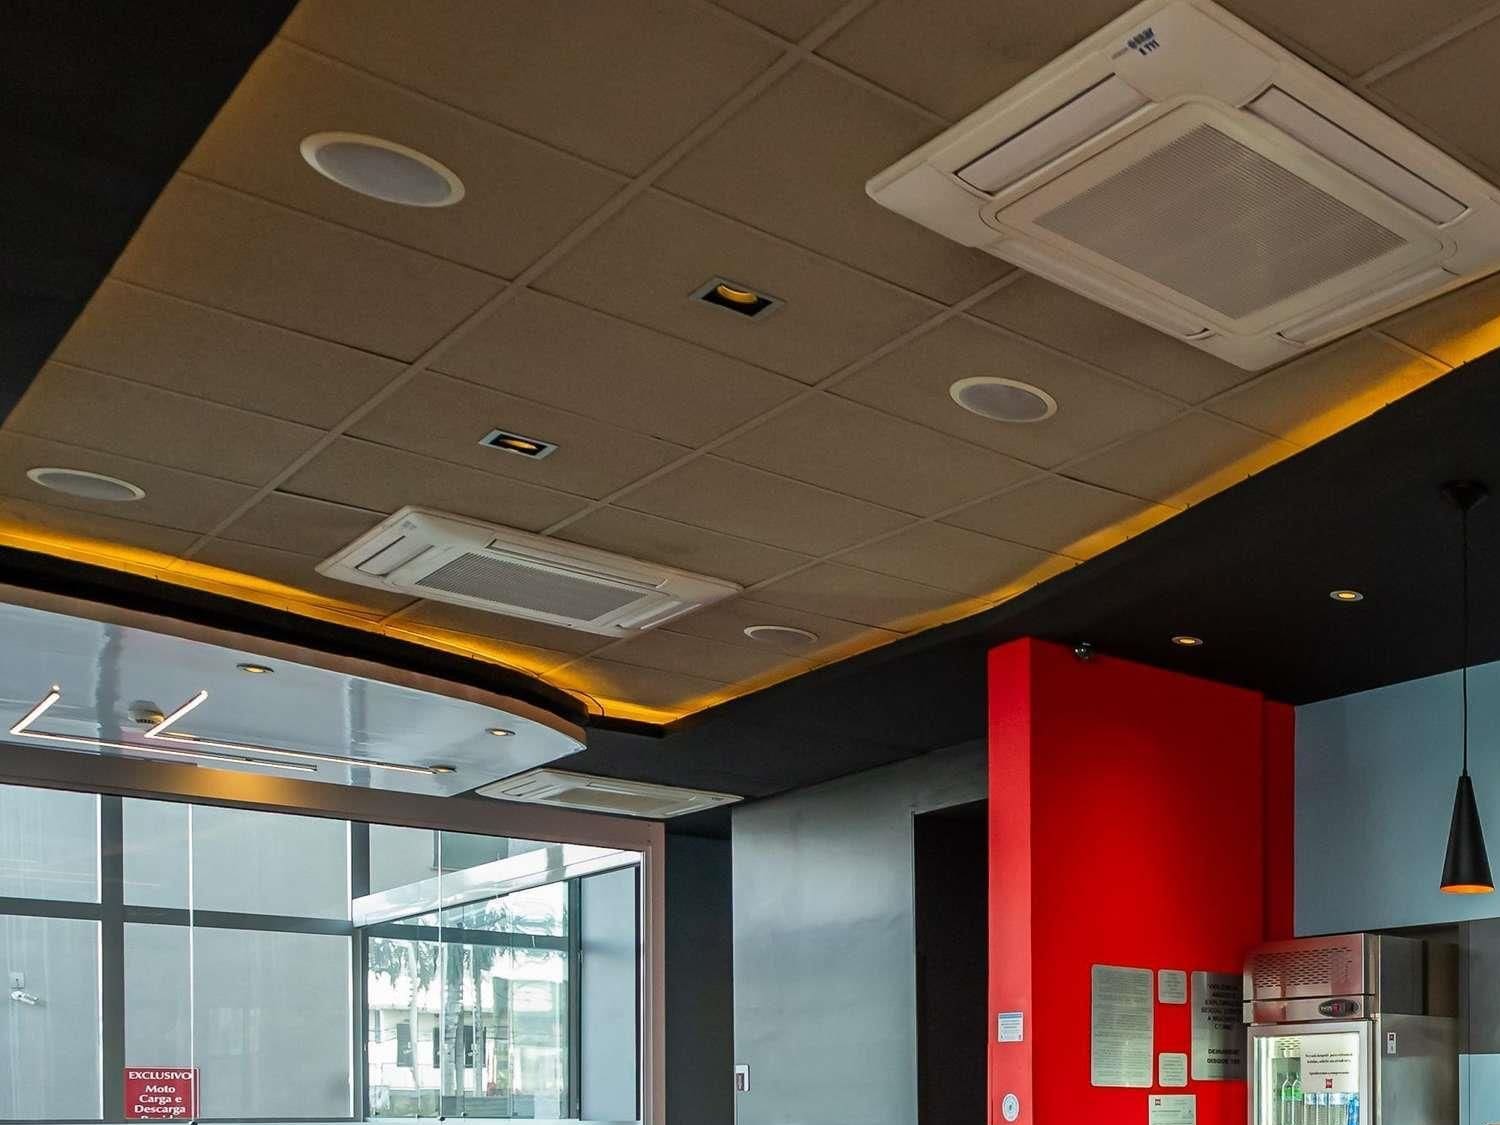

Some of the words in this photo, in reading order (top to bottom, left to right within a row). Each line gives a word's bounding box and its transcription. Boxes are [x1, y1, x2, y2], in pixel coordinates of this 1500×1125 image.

[128, 1071, 193, 1080] EXCLUSIVO
[145, 1085, 176, 1093] Moto
[139, 1094, 171, 1105] Carga
[134, 1104, 186, 1116] Descarga
